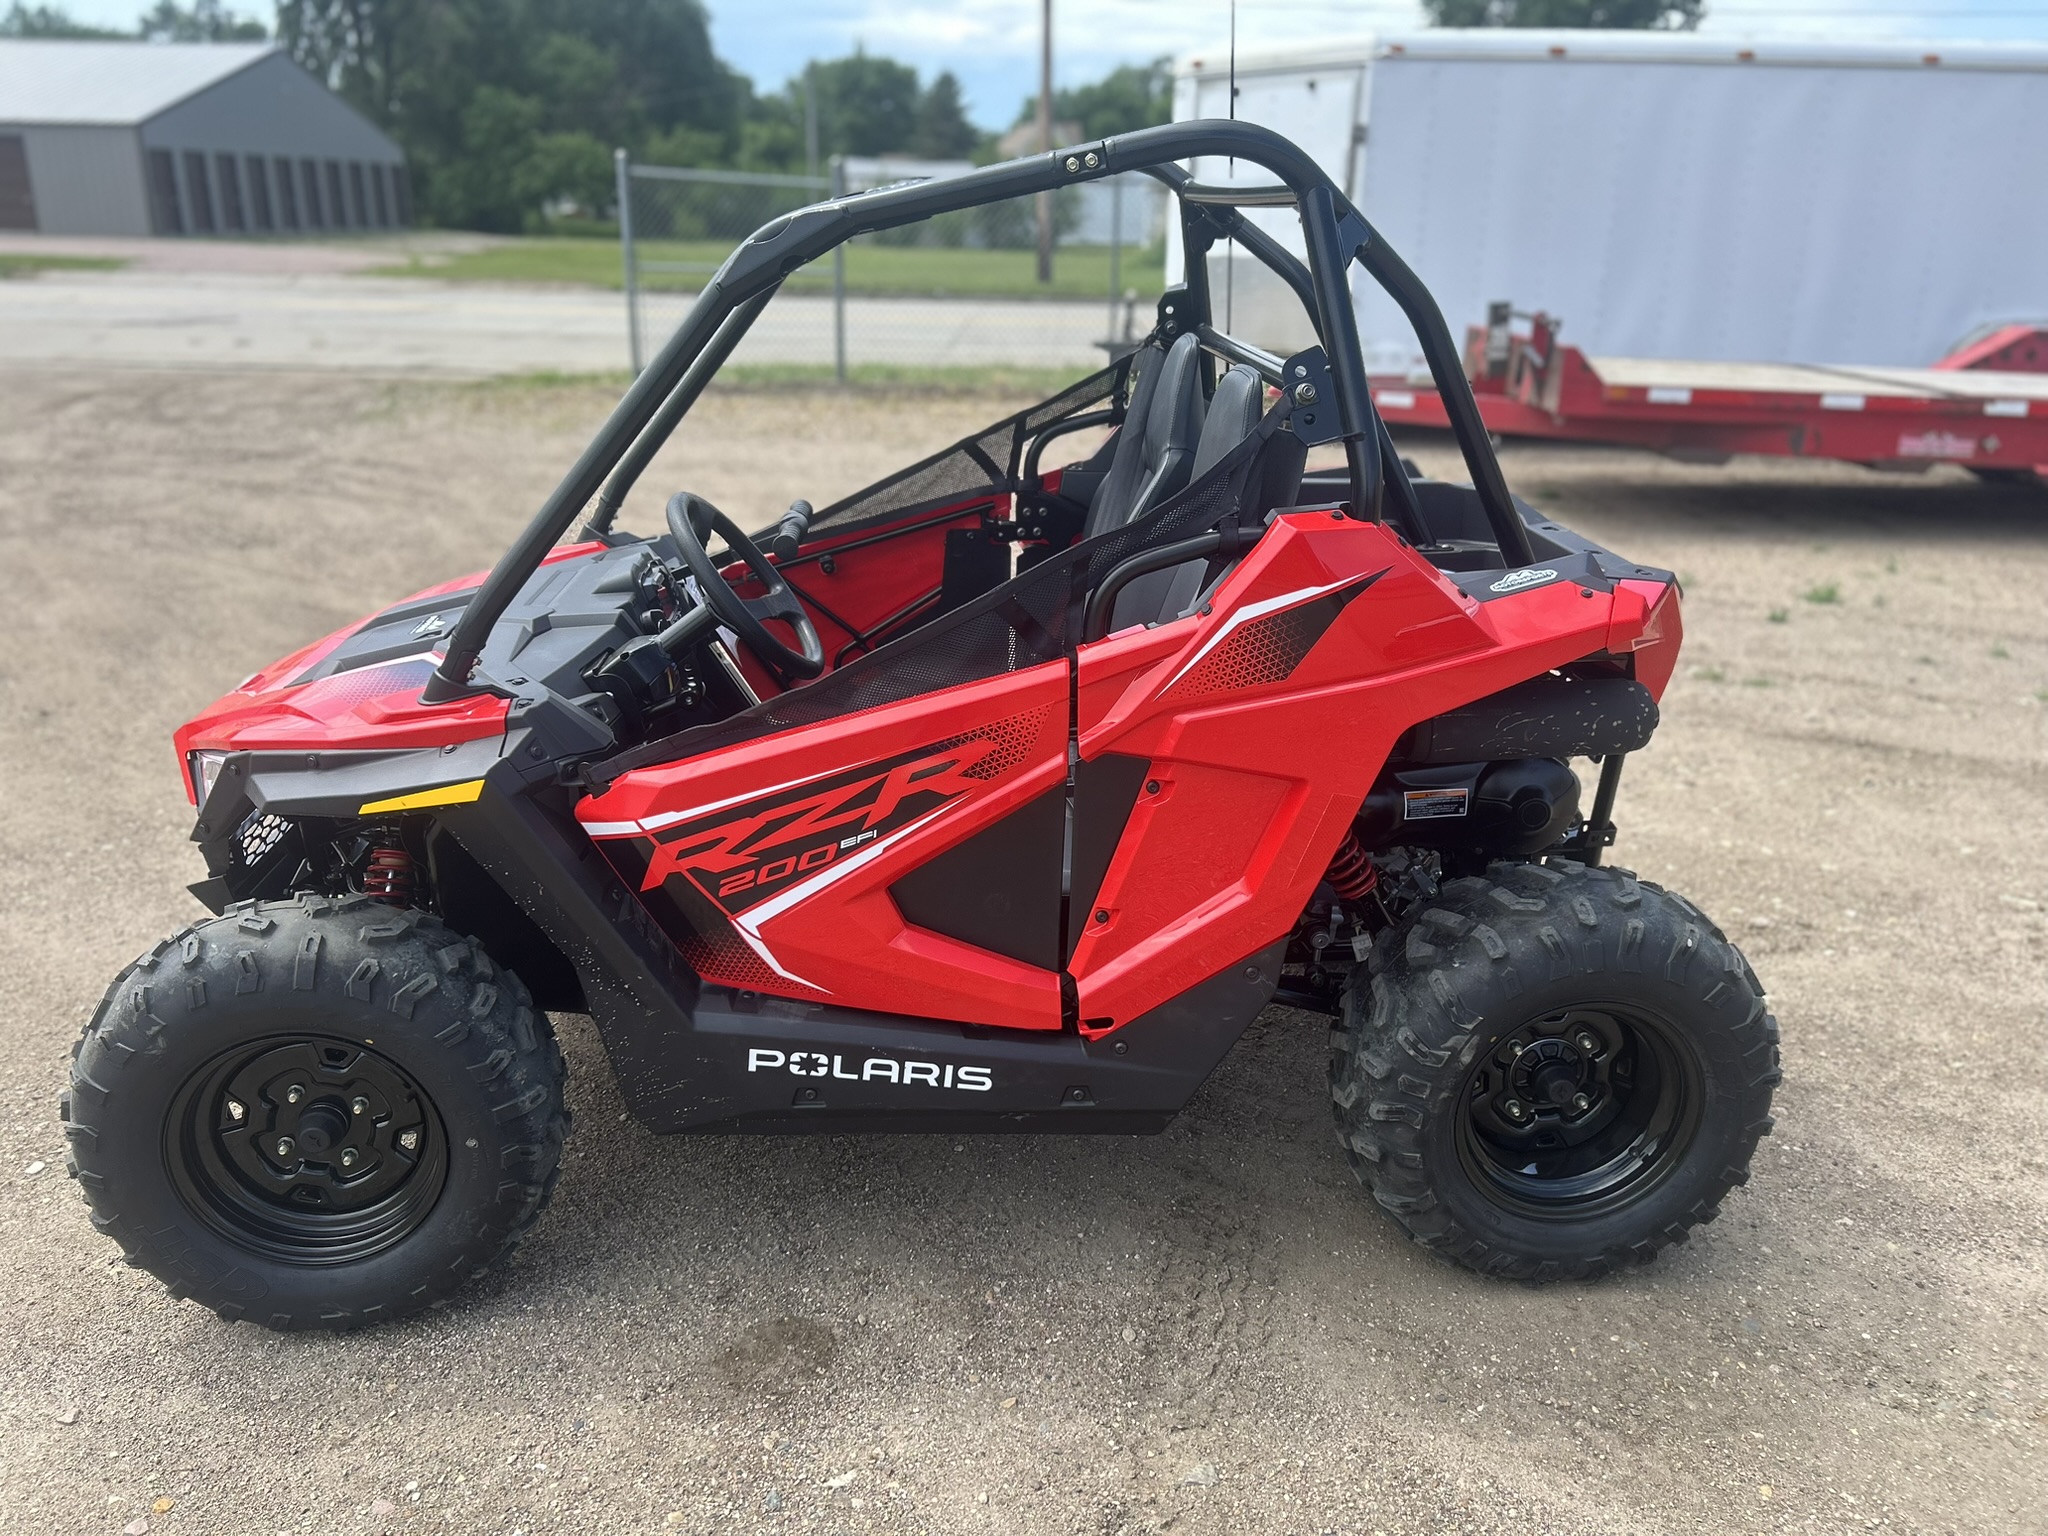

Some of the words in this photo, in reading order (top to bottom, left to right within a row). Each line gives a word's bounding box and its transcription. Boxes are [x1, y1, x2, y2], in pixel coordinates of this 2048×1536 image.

[640, 738, 1002, 892] RZR
[718, 843, 838, 897] 200
[840, 829, 878, 849] EFI
[748, 1048, 993, 1091] POLARIS
